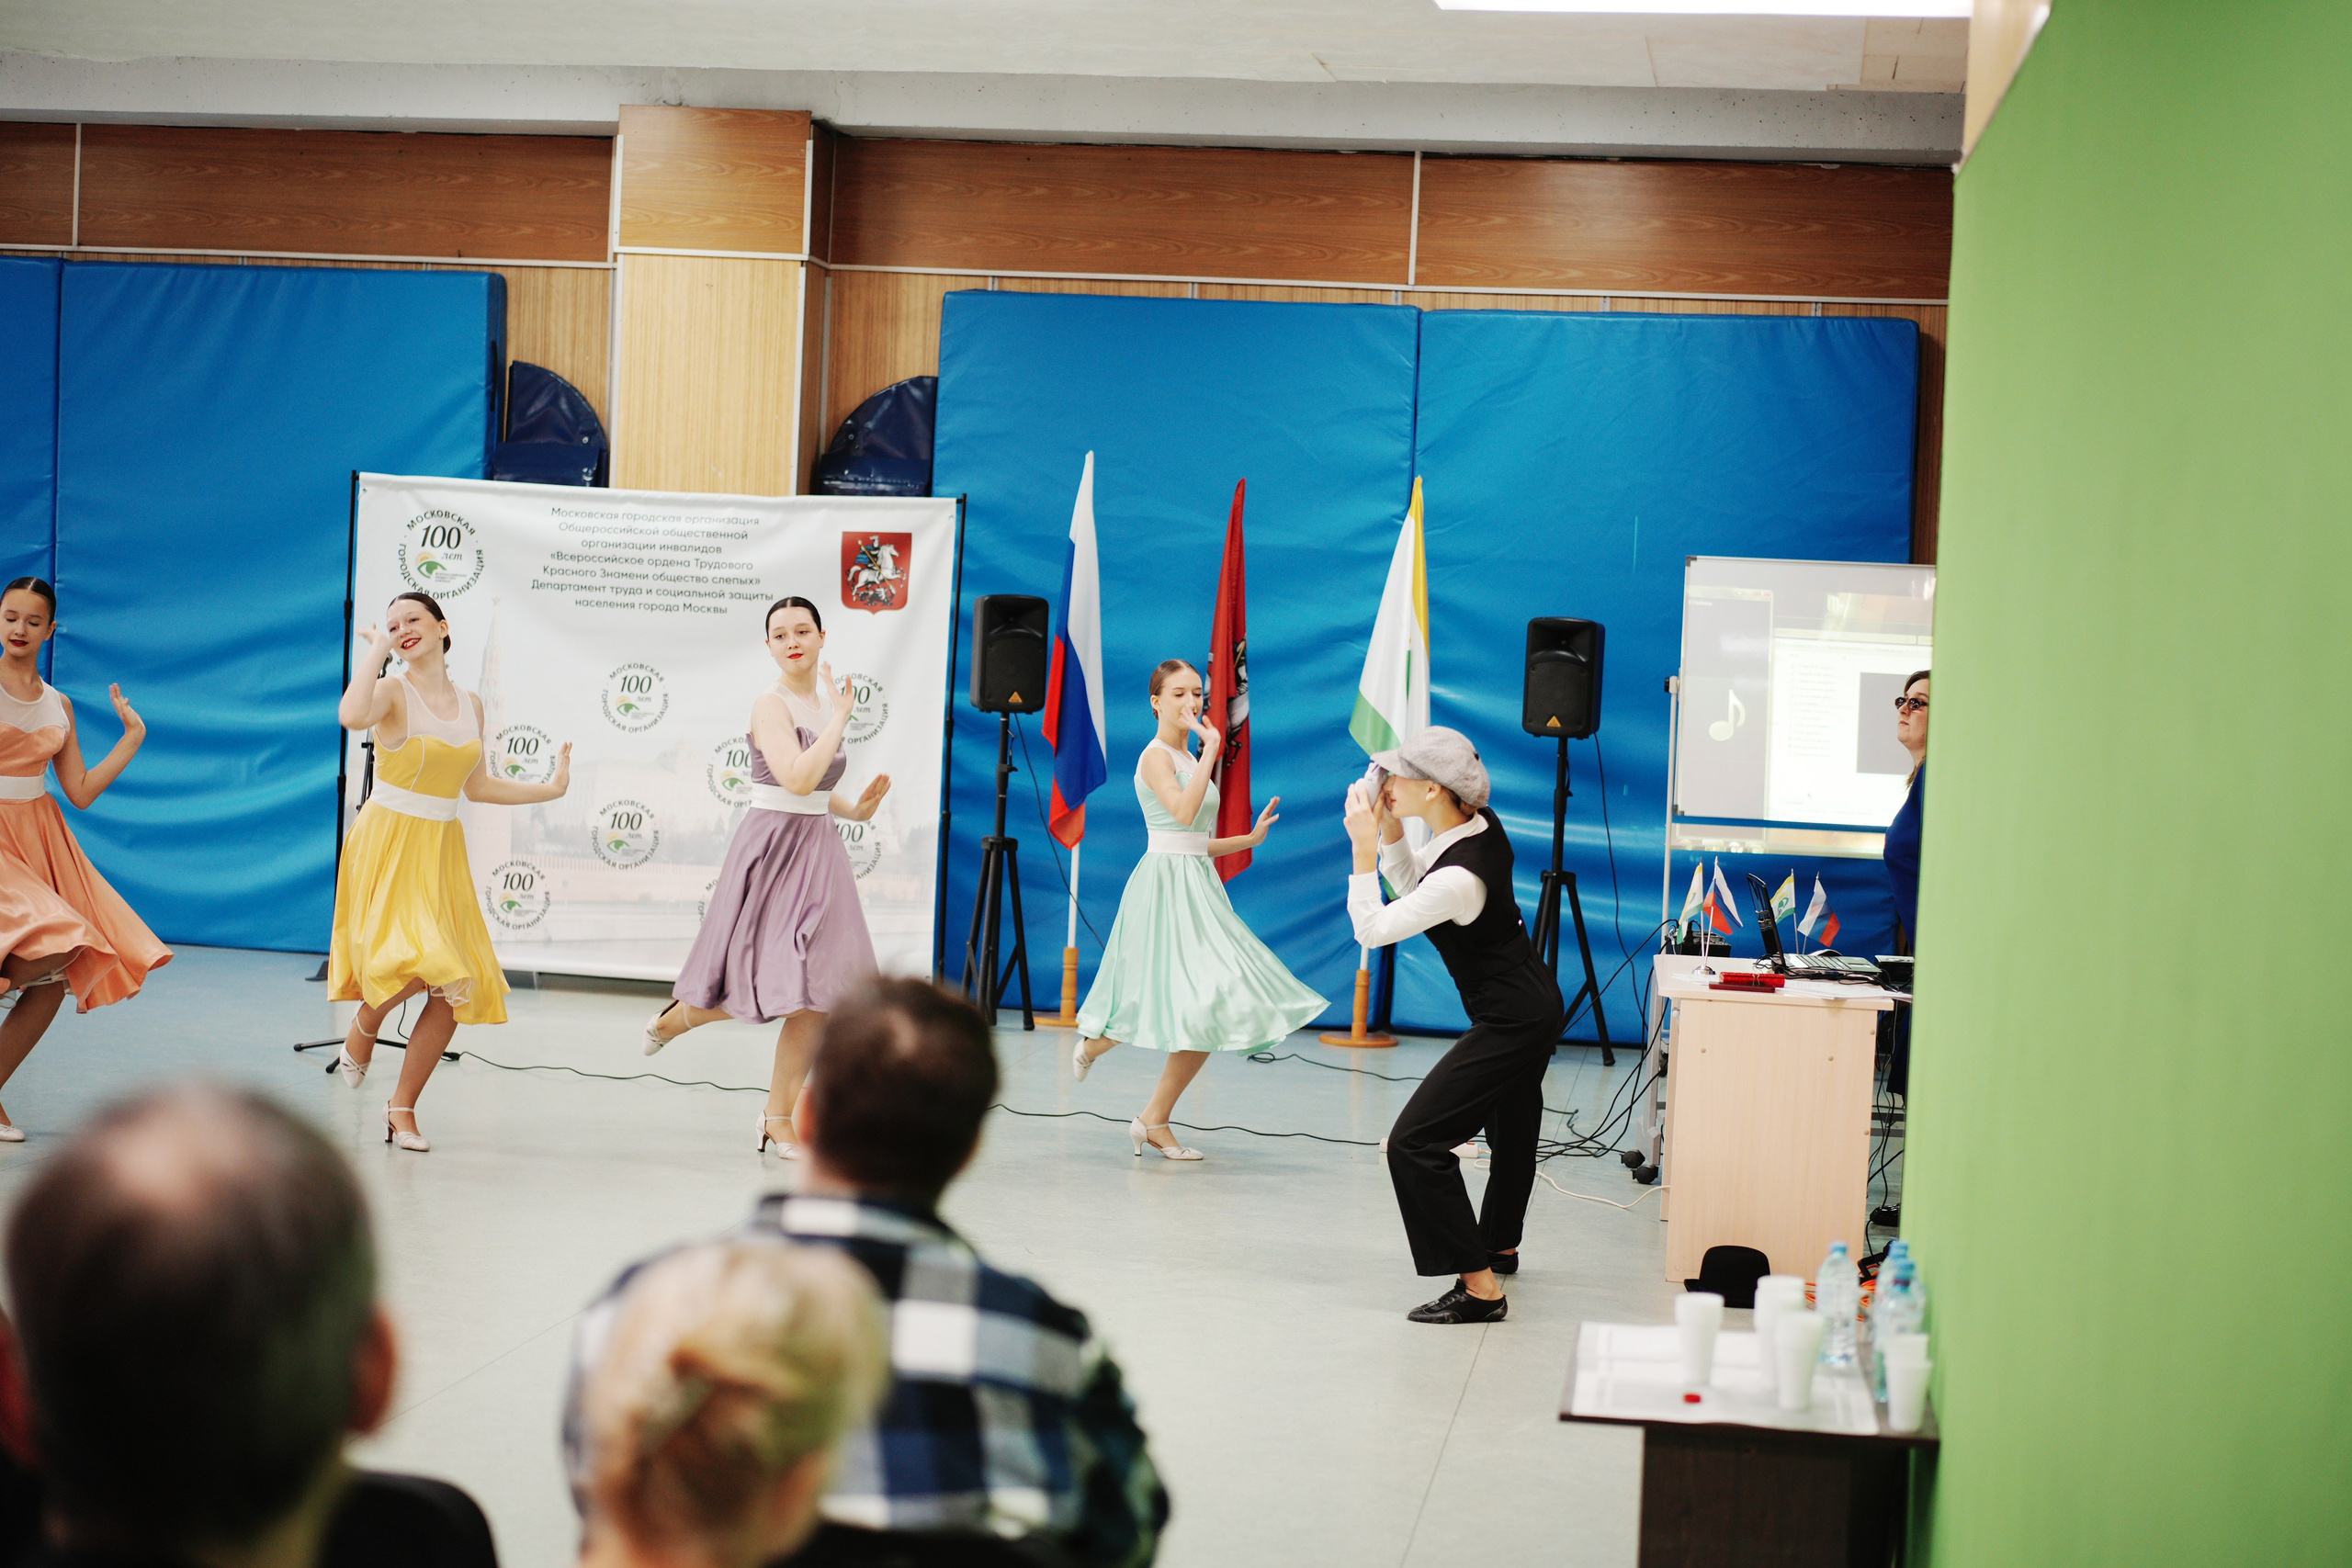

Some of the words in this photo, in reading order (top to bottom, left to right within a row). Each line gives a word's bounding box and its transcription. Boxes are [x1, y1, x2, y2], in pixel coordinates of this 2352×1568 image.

[407, 510, 475, 536] МОСКОВСКАЯ
[551, 507, 619, 520] Московская
[621, 513, 681, 524] городская
[685, 515, 759, 525] организация
[422, 525, 461, 549] 100
[559, 523, 659, 536] Общероссийской
[662, 527, 748, 540] общественной
[582, 539, 656, 551] организации
[660, 544, 721, 554] инвалидов
[550, 551, 643, 565] «Всероссийское
[648, 557, 690, 568] ордена
[694, 558, 753, 571] Трудового
[399, 544, 429, 596] ГОРОДСКАЯ
[433, 550, 484, 600] ОРГАНИЗАЦИЯ
[543, 566, 596, 578] Красного
[600, 569, 649, 581] Знамени
[652, 571, 708, 584] общество
[712, 576, 760, 586] слепых»
[532, 580, 606, 593] Департамент
[610, 585, 642, 596] труда
[656, 588, 725, 600] социальной
[729, 592, 773, 602] защиты
[575, 598, 635, 609] населения
[639, 602, 679, 613] города
[684, 603, 728, 615] Москвы
[610, 663, 664, 682] МОСКОВСКАЯ
[621, 675, 651, 694] 100
[602, 690, 626, 731] ГОРОДСКАЯ
[628, 694, 669, 733] ОРГАНИЗАЦИЯ
[848, 704, 889, 744] ОРГАНИЗАЦИЯ
[496, 725, 551, 744] МОСКОВСКАЯ
[507, 737, 538, 755] 100
[707, 764, 731, 806] ГОРОДСКАЯ
[600, 800, 654, 818] МОСКОВСКАЯ
[611, 812, 642, 830] 100
[592, 826, 616, 867] ГОРОДСКАЯ
[619, 830, 659, 870] ОРГАНИЗАЦИЯ
[492, 861, 545, 880] МОСКОВСКАЯ
[855, 842, 881, 880] АНИЗАЦИЯ
[503, 873, 534, 891] 100
[486, 886, 510, 928] ГОРОДСКАЯ
[513, 891, 550, 930] ОРГАНИЗАЦИЯ
